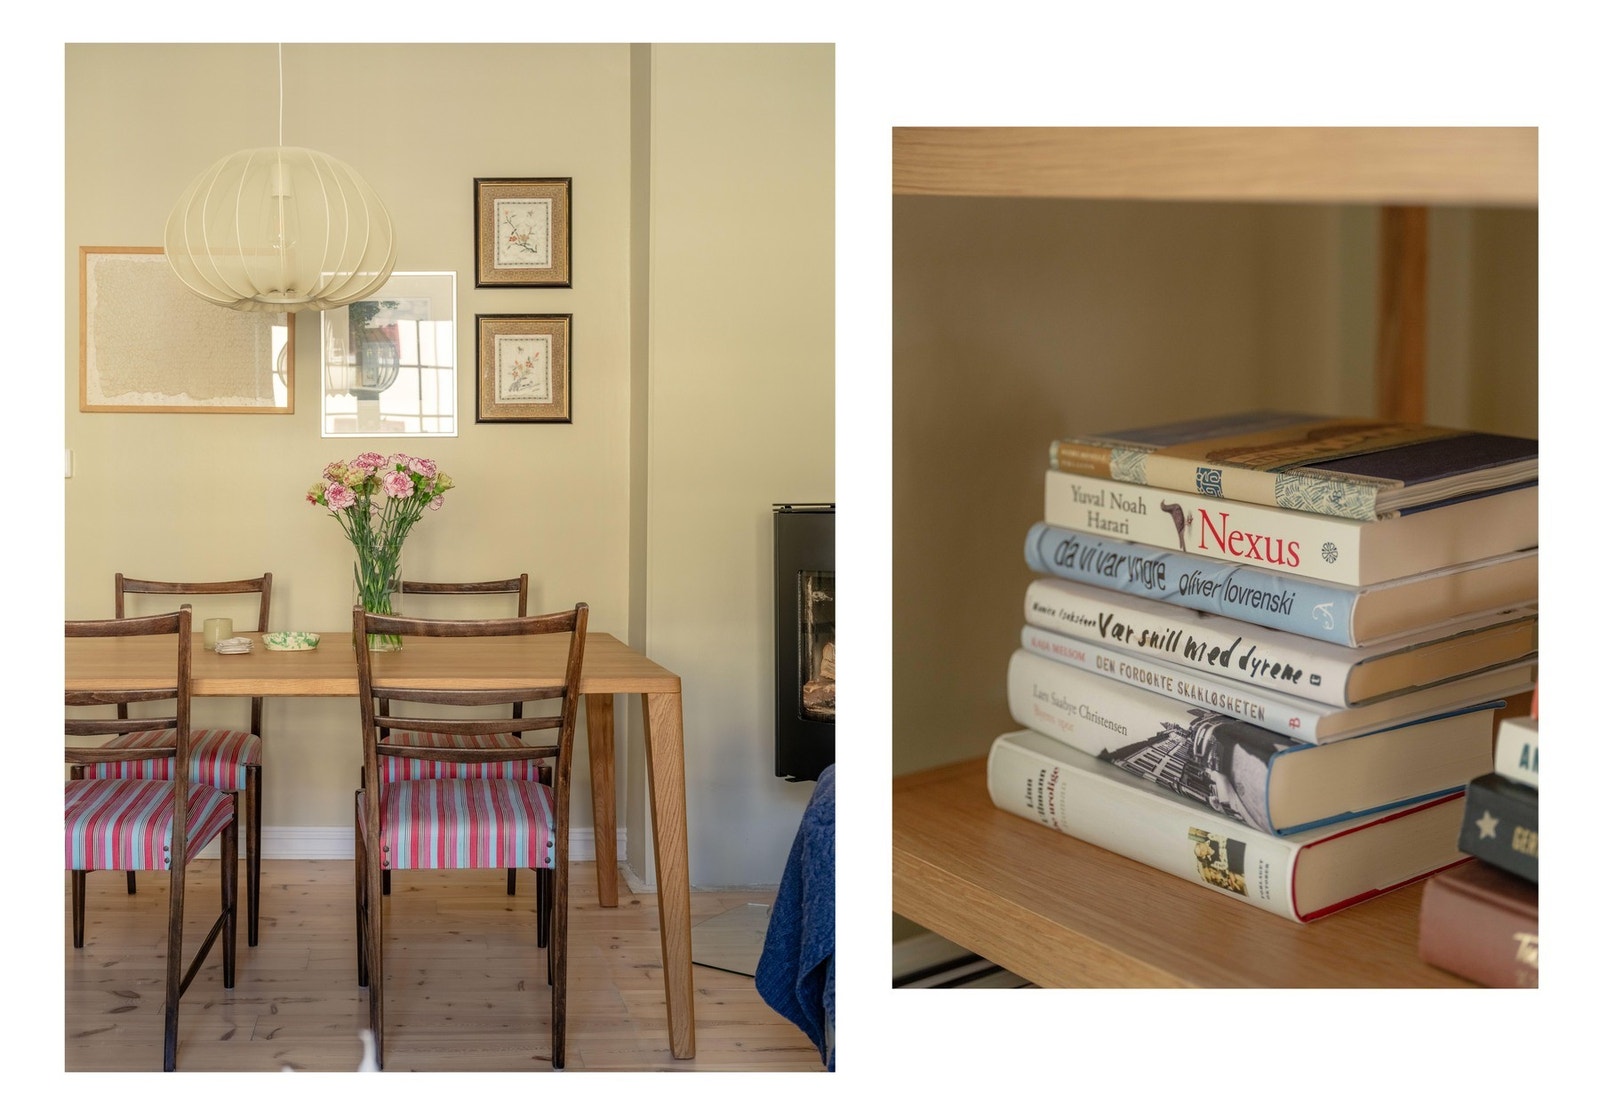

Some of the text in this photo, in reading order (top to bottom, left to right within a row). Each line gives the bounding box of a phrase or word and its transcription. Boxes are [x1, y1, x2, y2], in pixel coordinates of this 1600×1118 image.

[1071, 484, 1147, 515] Yuval Noah
[1087, 510, 1129, 534] Harari
[1198, 508, 1300, 567] Nexus
[1054, 536, 1166, 591] da vi var yngre
[1179, 570, 1296, 615] oliver lovrenski
[1096, 655, 1116, 674] DEN
[1098, 612, 1303, 684] Vær snill med dyrene
[1079, 704, 1128, 736] Christensen
